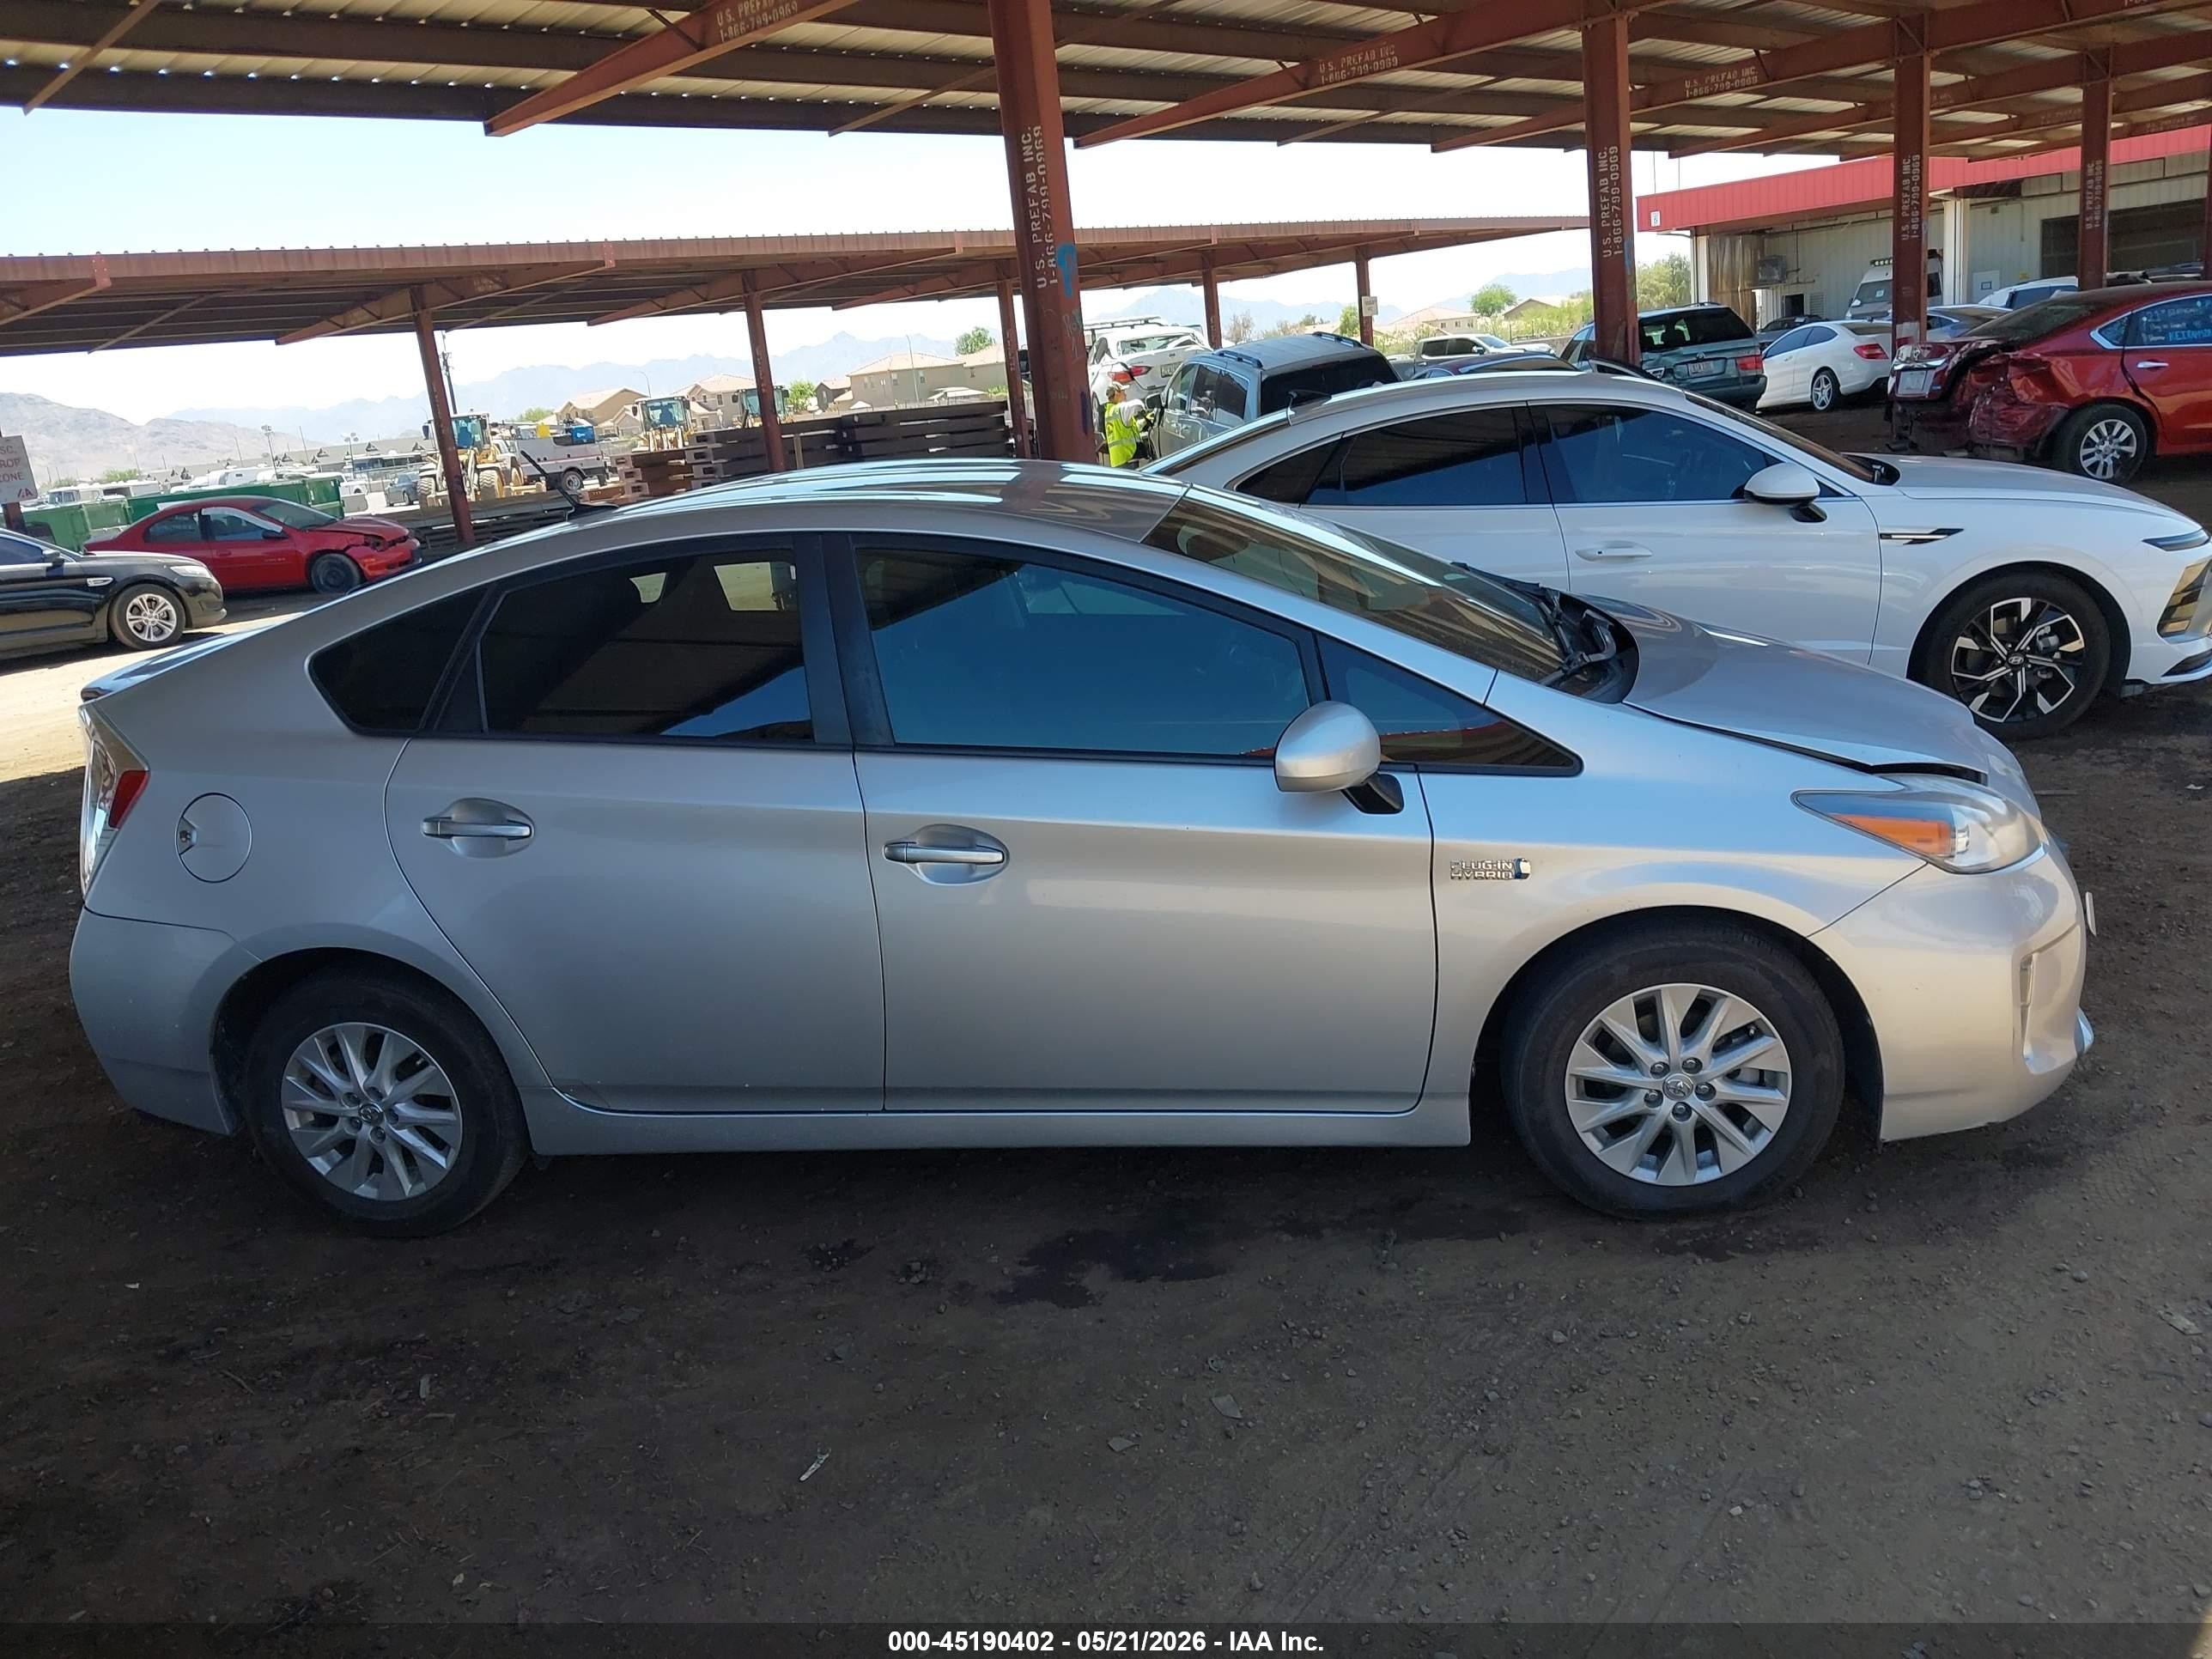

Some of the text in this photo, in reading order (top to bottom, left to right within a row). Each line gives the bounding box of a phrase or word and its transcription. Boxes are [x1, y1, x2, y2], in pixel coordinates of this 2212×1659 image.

[1340, 50, 1376, 68] PREFAB
[1021, 126, 1048, 289] U.S. PREFAB INC.
[1033, 125, 1059, 285] 1-866-799-0969
[1598, 146, 1613, 258] U.S. PREFAB INC.
[1608, 146, 1623, 255] 1-866-799-0969
[1900, 179, 1911, 217] PREFAB
[0, 445, 16, 455] SC.
[0, 459, 21, 469] ROP
[1449, 871, 1513, 880] HYBRID
